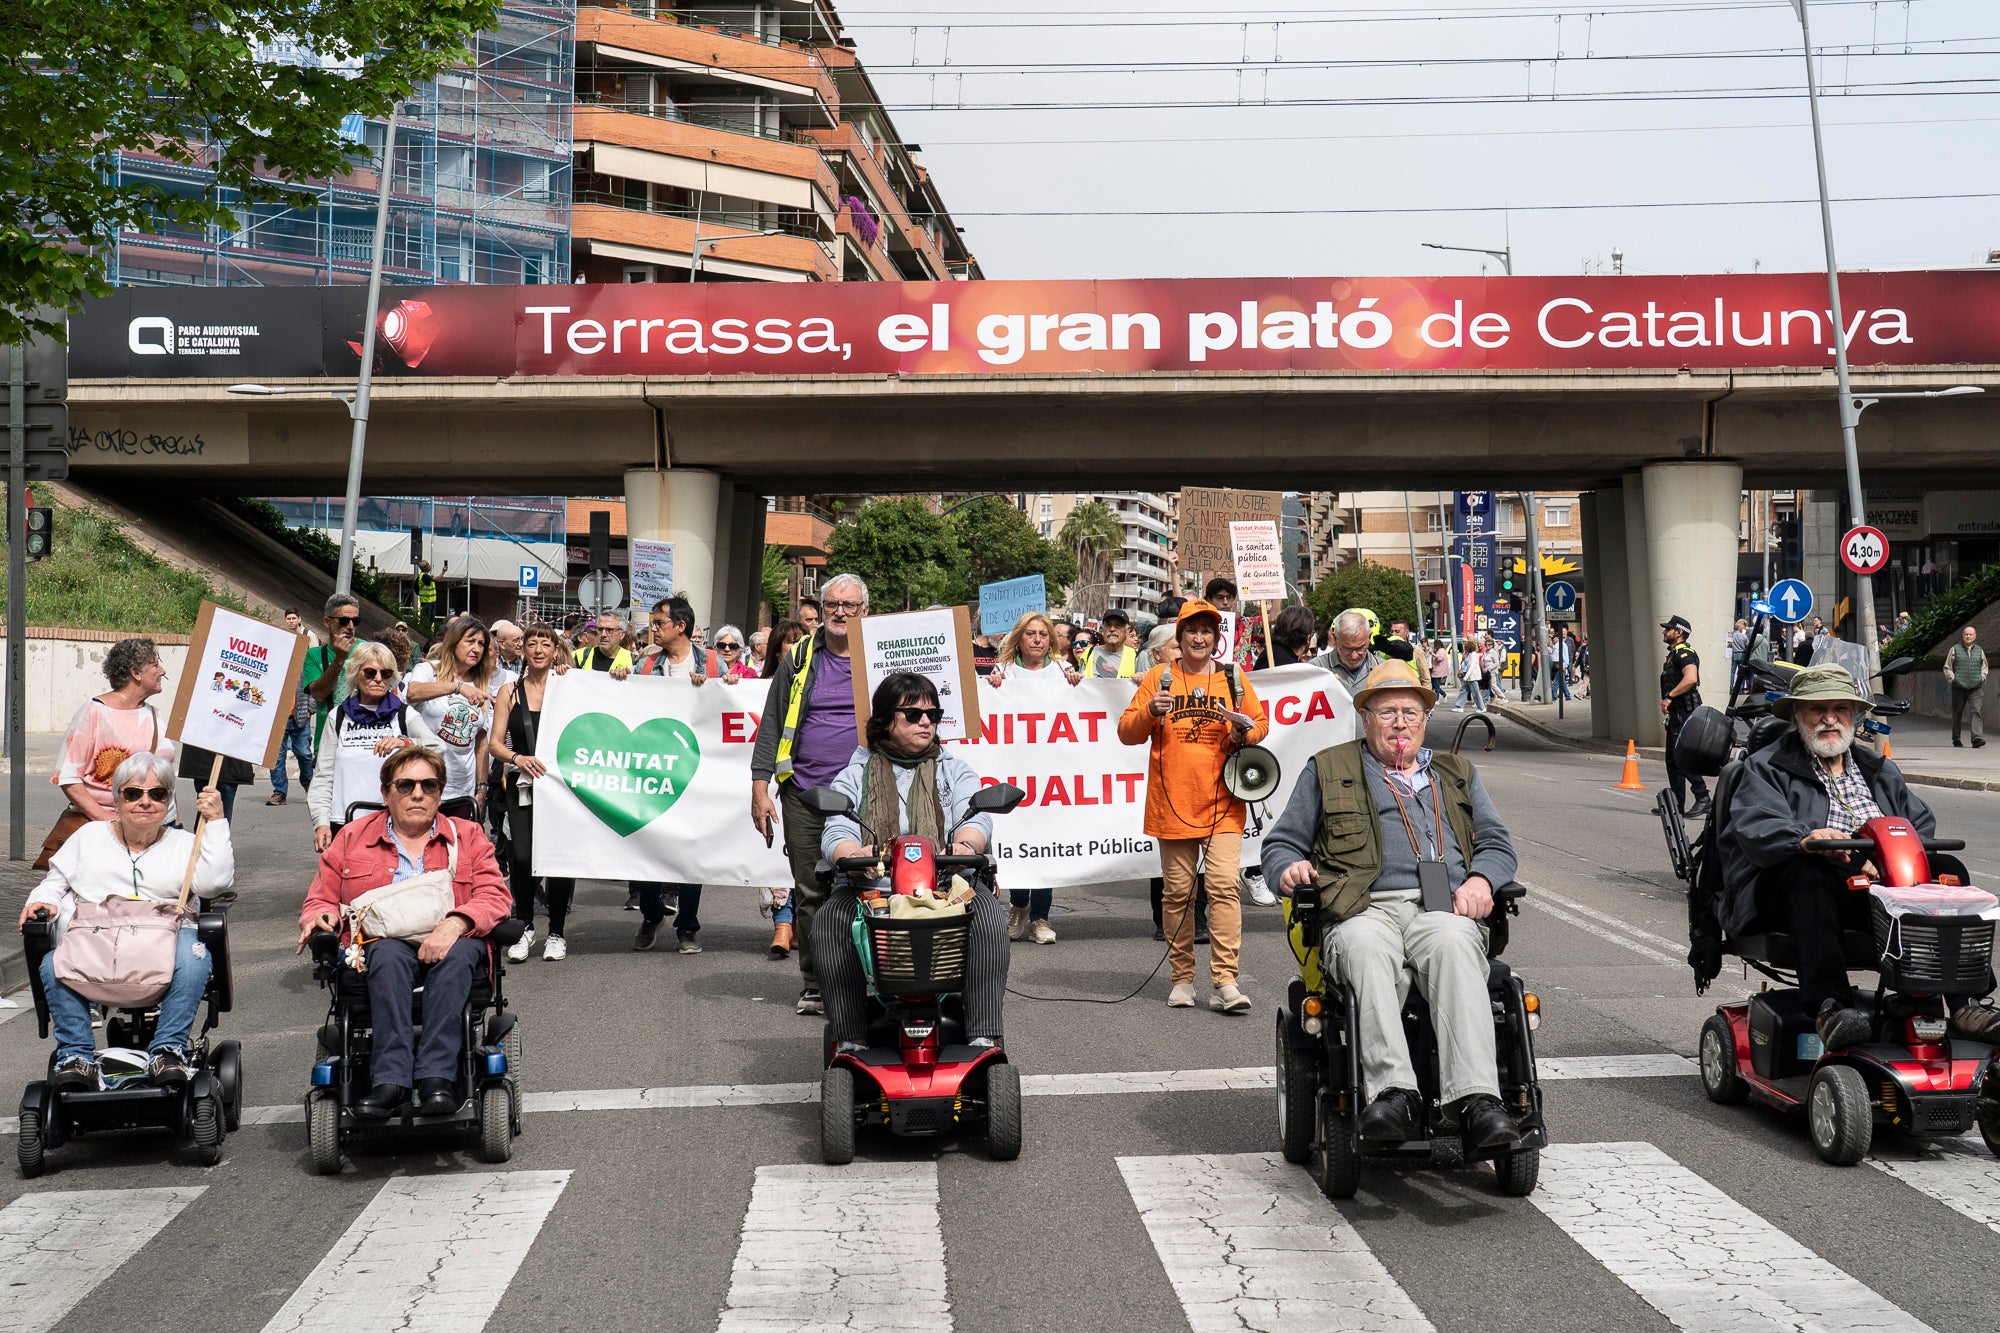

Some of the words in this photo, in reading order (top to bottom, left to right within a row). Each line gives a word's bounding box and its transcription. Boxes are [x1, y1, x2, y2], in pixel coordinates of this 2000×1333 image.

[178, 326, 201, 336] PARC
[202, 326, 260, 336] AUDIOVISUAL
[524, 306, 853, 361] Terrassa,
[877, 303, 949, 352] el
[976, 312, 1161, 365] gran
[1188, 297, 1393, 362] plató
[1420, 299, 1511, 349] de
[1537, 296, 1914, 356] Catalunya
[178, 337, 190, 347] DE
[192, 337, 240, 347] CATALUNYA
[1184, 490, 1234, 509] MIENTRAS
[1185, 508, 1198, 526] SE
[1200, 509, 1233, 528] NUTRE
[1867, 510, 1919, 518] ANYTIME
[1958, 521, 2000, 531] entrada
[1236, 543, 1244, 551] la
[1237, 552, 1268, 565] pública
[523, 568, 535, 586] P
[1253, 570, 1280, 578] Qualitat
[1488, 618, 1496, 629] P
[229, 637, 268, 661] VOLEM
[877, 633, 946, 651] REHABILITACIÓ
[220, 650, 269, 673] ESPECIALISTES
[884, 646, 939, 660] CONTINUADA
[221, 662, 229, 670] EN
[229, 664, 262, 680] DISCAPACITAT
[873, 661, 884, 669] PER
[890, 658, 918, 667] MALALTIES
[941, 712, 1107, 744] NITAT
[574, 747, 679, 771] SANITAT
[571, 769, 675, 796] PÚBLICA
[980, 773, 1144, 807] UALIT
[998, 842, 1013, 859] la
[1018, 840, 1083, 858] Sanitat
[1088, 837, 1153, 856] Pública
